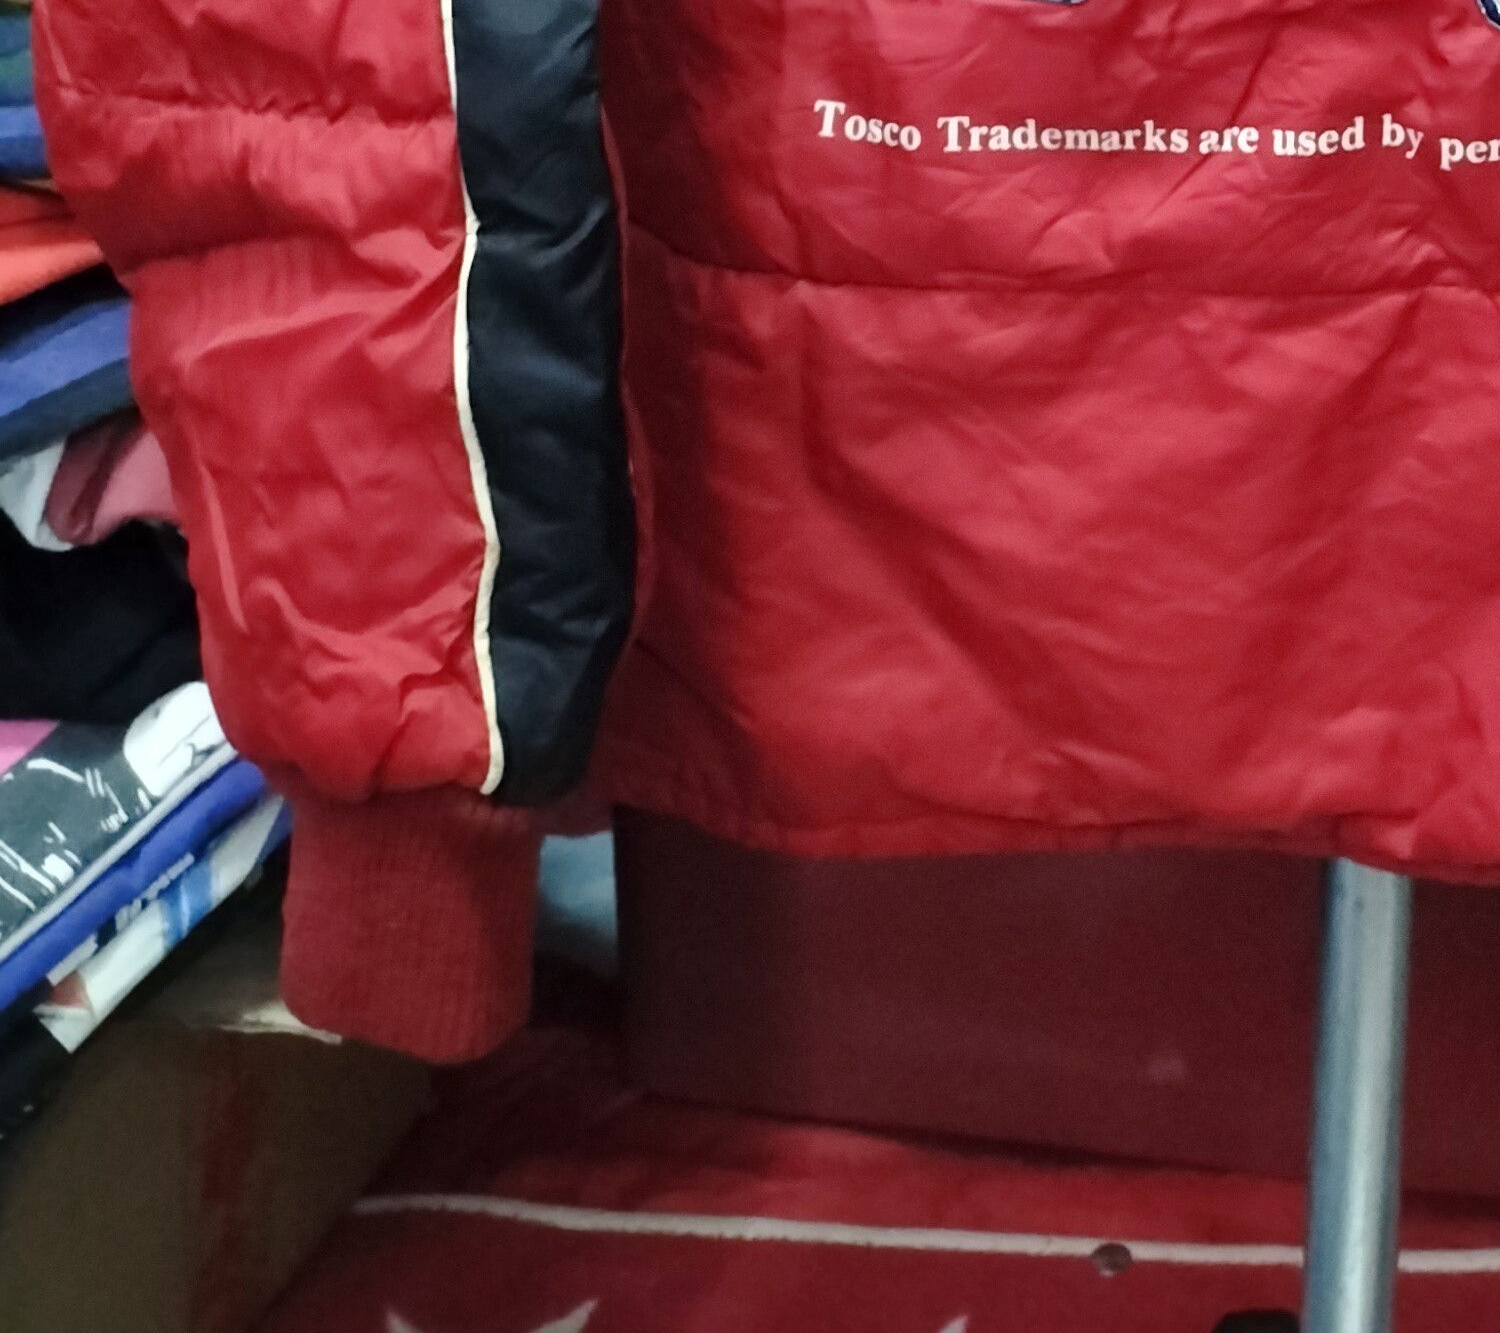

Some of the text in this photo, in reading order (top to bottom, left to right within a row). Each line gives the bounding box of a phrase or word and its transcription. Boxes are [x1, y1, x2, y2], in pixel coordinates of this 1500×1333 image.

[813, 99, 921, 151] Tosco
[937, 115, 1189, 152] Trademarks
[1199, 125, 1259, 154] are
[1272, 116, 1365, 156] used
[1382, 113, 1423, 158] by
